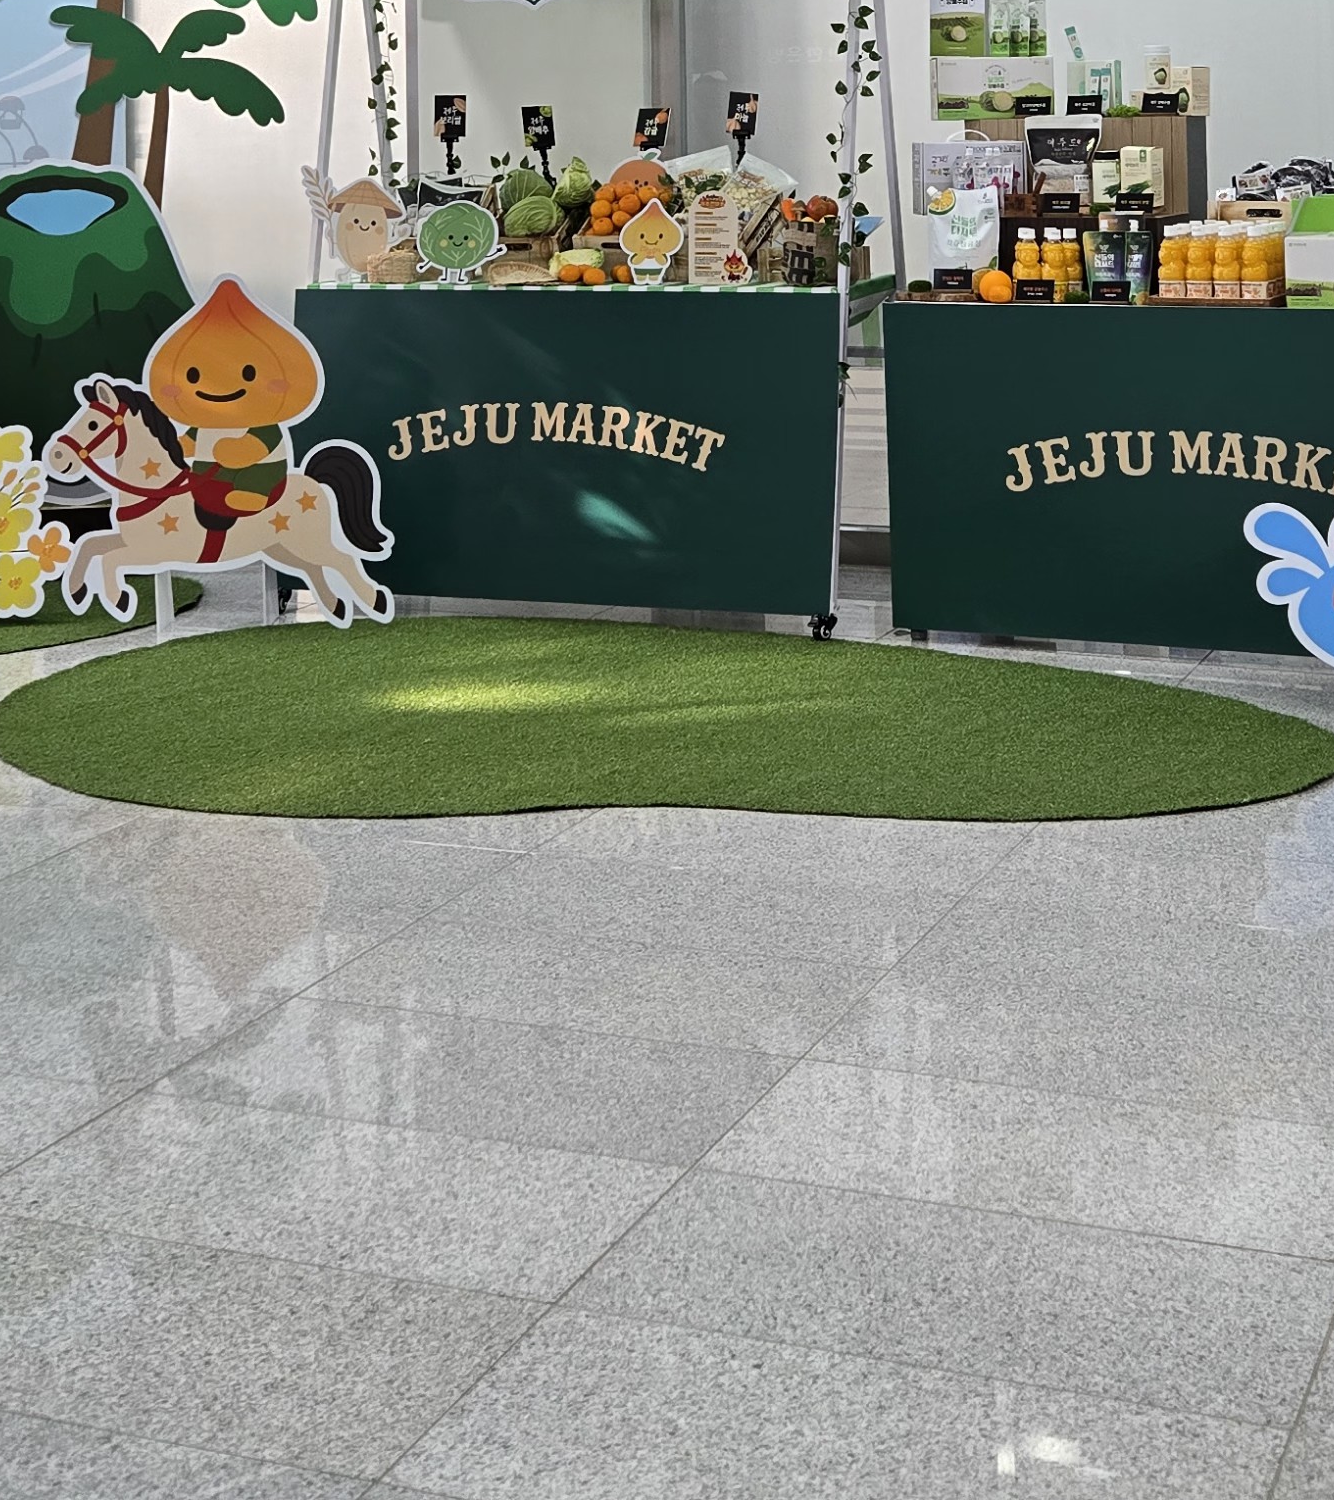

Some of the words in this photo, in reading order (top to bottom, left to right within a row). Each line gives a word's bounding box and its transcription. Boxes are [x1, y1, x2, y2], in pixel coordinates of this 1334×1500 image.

[442, 105, 458, 116] 제주
[530, 115, 545, 126] 제주
[388, 402, 521, 461] JEJU
[530, 402, 726, 473] MARKET
[1005, 430, 1155, 492] JEJU
